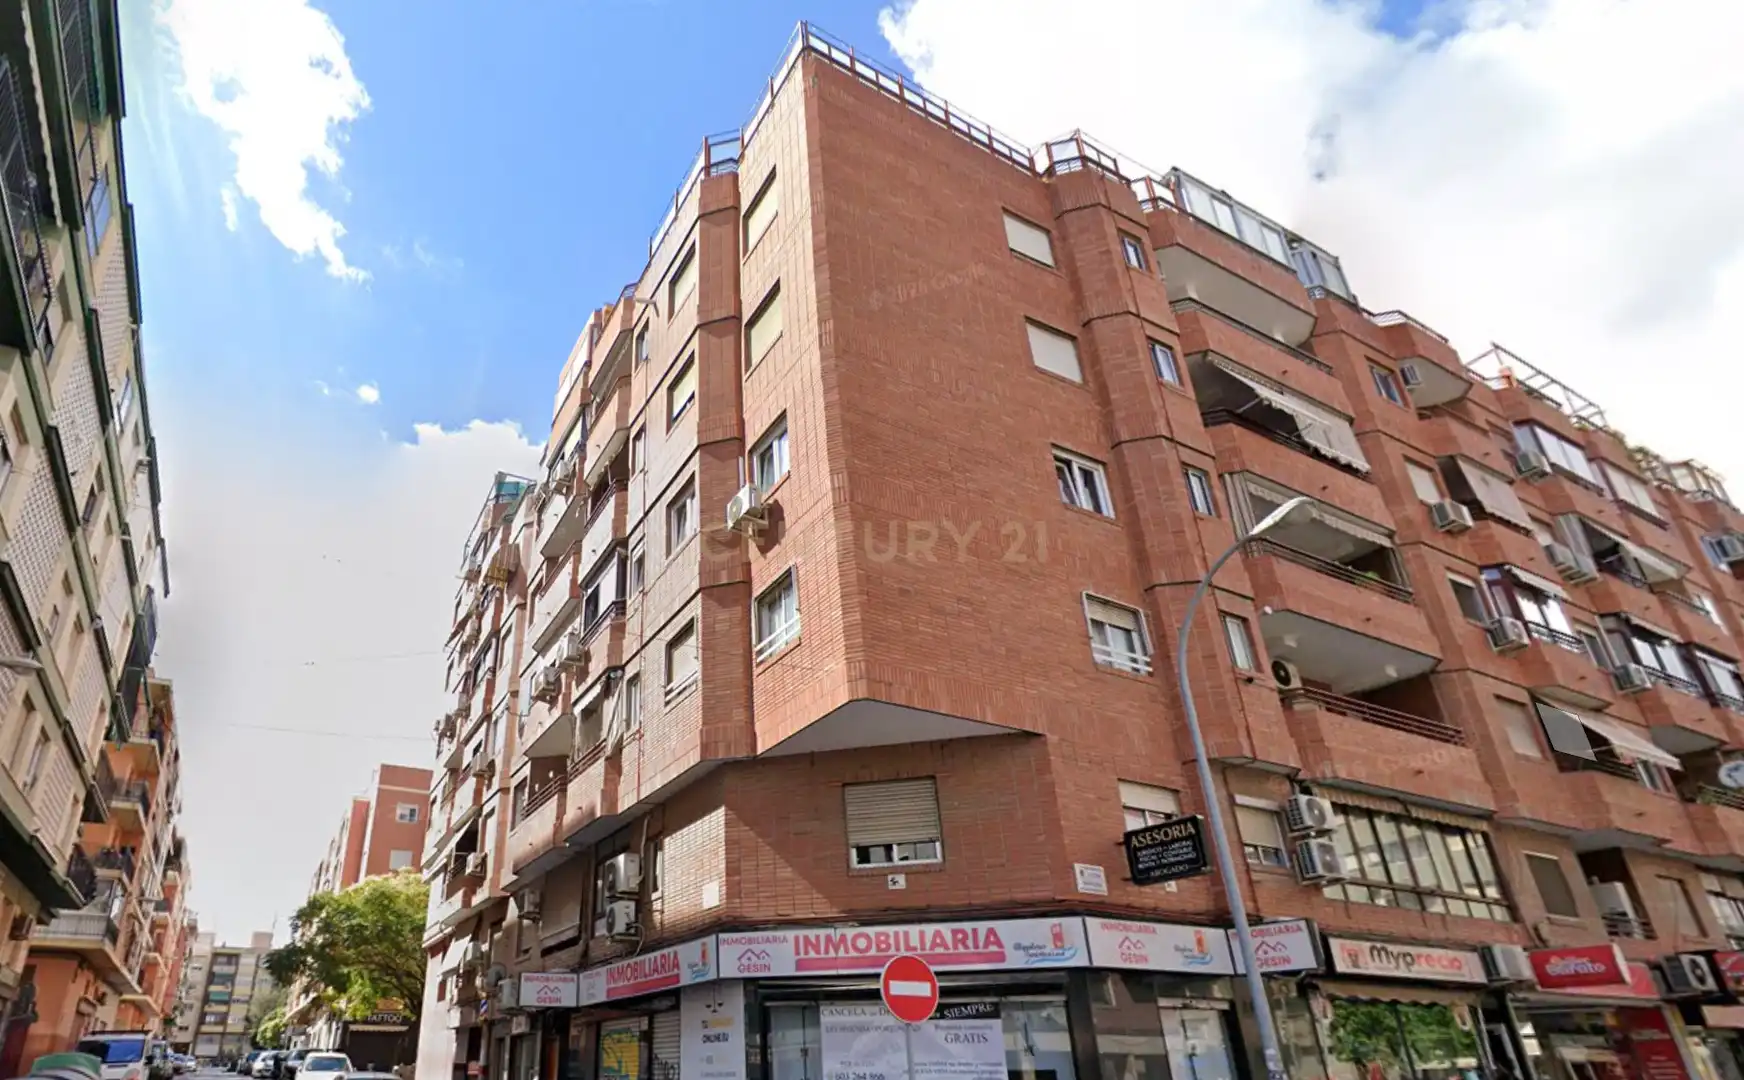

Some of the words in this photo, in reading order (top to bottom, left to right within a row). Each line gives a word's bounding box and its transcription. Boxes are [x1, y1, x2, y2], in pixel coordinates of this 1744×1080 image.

[1131, 821, 1196, 849] ASESORIA
[719, 934, 789, 947] INMOBILIARIA
[793, 926, 1006, 958] INMOBILIARIA
[606, 950, 681, 986] INMOBILIARIA
[821, 1006, 868, 1018] CANCELA
[943, 1002, 995, 1021] SIEMPRE
[943, 1032, 989, 1044] GRATIS
